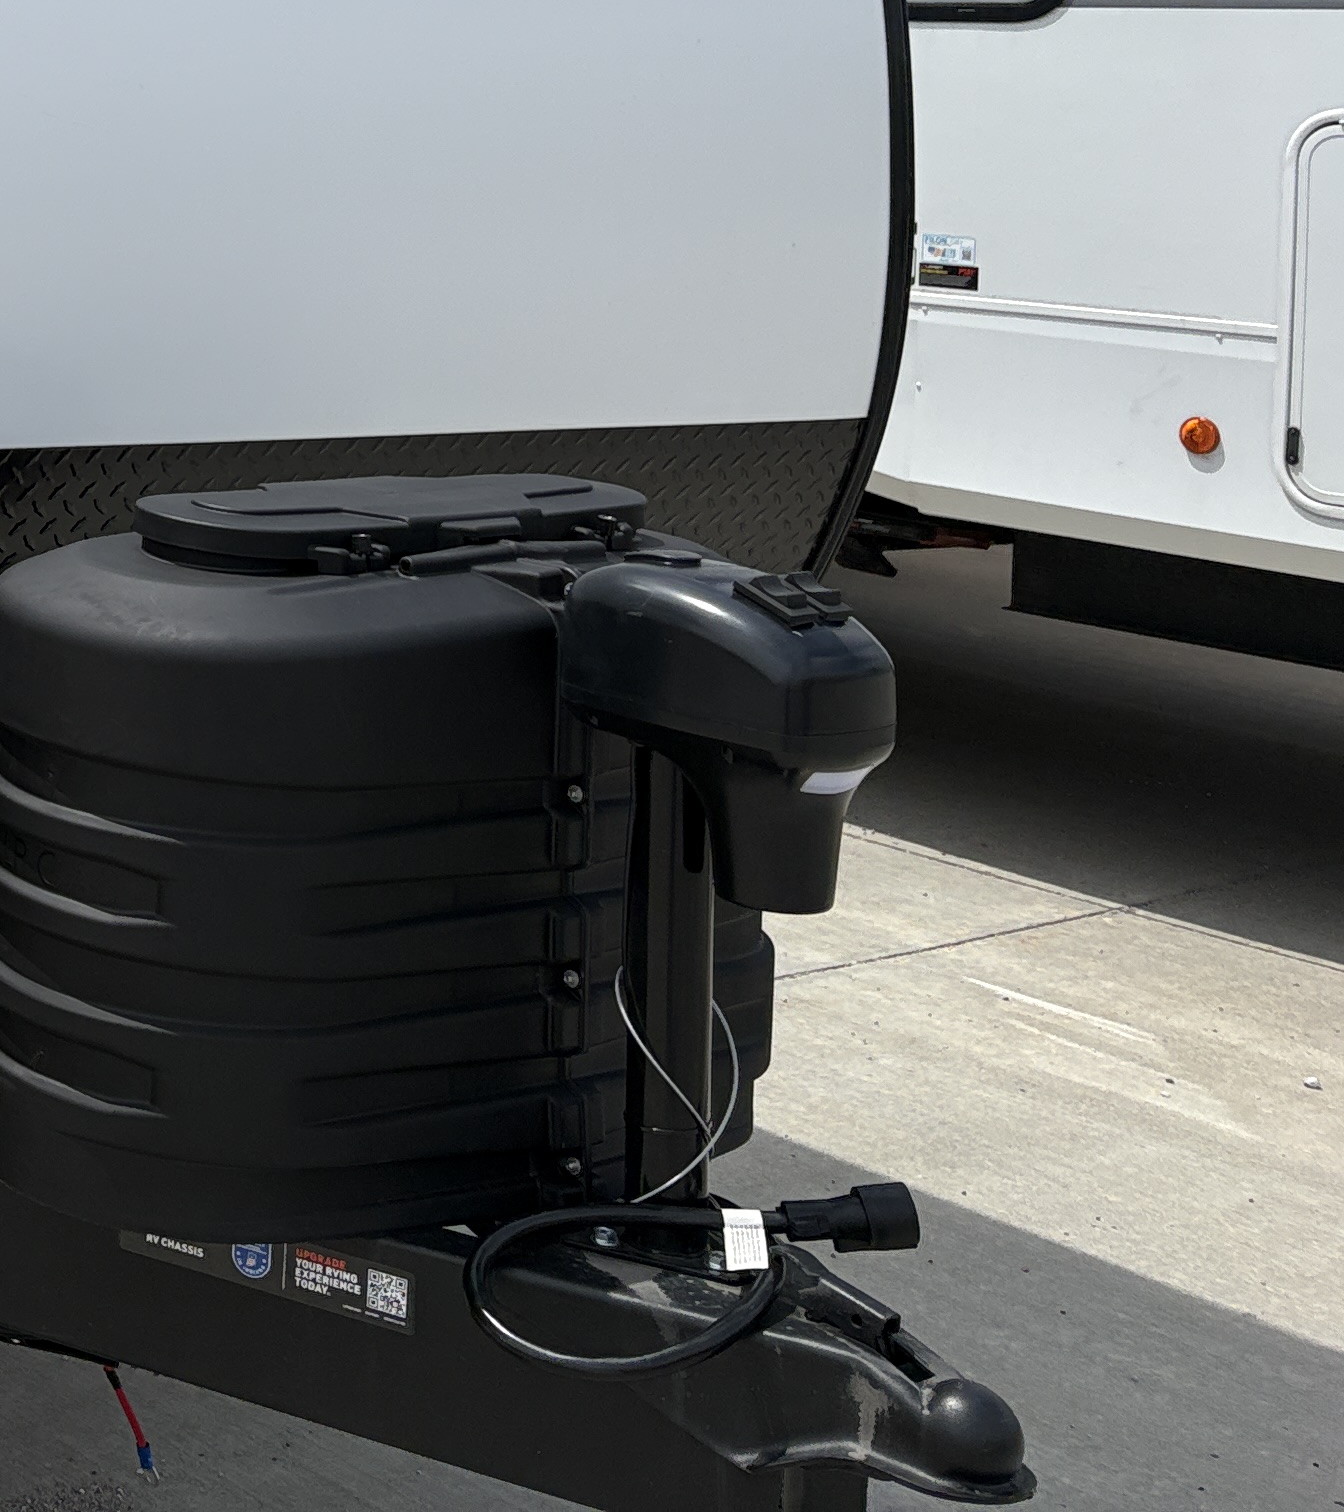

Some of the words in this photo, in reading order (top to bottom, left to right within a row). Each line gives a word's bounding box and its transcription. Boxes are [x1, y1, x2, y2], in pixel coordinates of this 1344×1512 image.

[146, 1233, 160, 1245] RV
[161, 1237, 205, 1259] CHASSIS
[295, 1248, 347, 1270] UPGRADE
[294, 1267, 362, 1296] EXPERIENCE
[295, 1257, 324, 1274] YOUR
[325, 1266, 358, 1284] RVING
